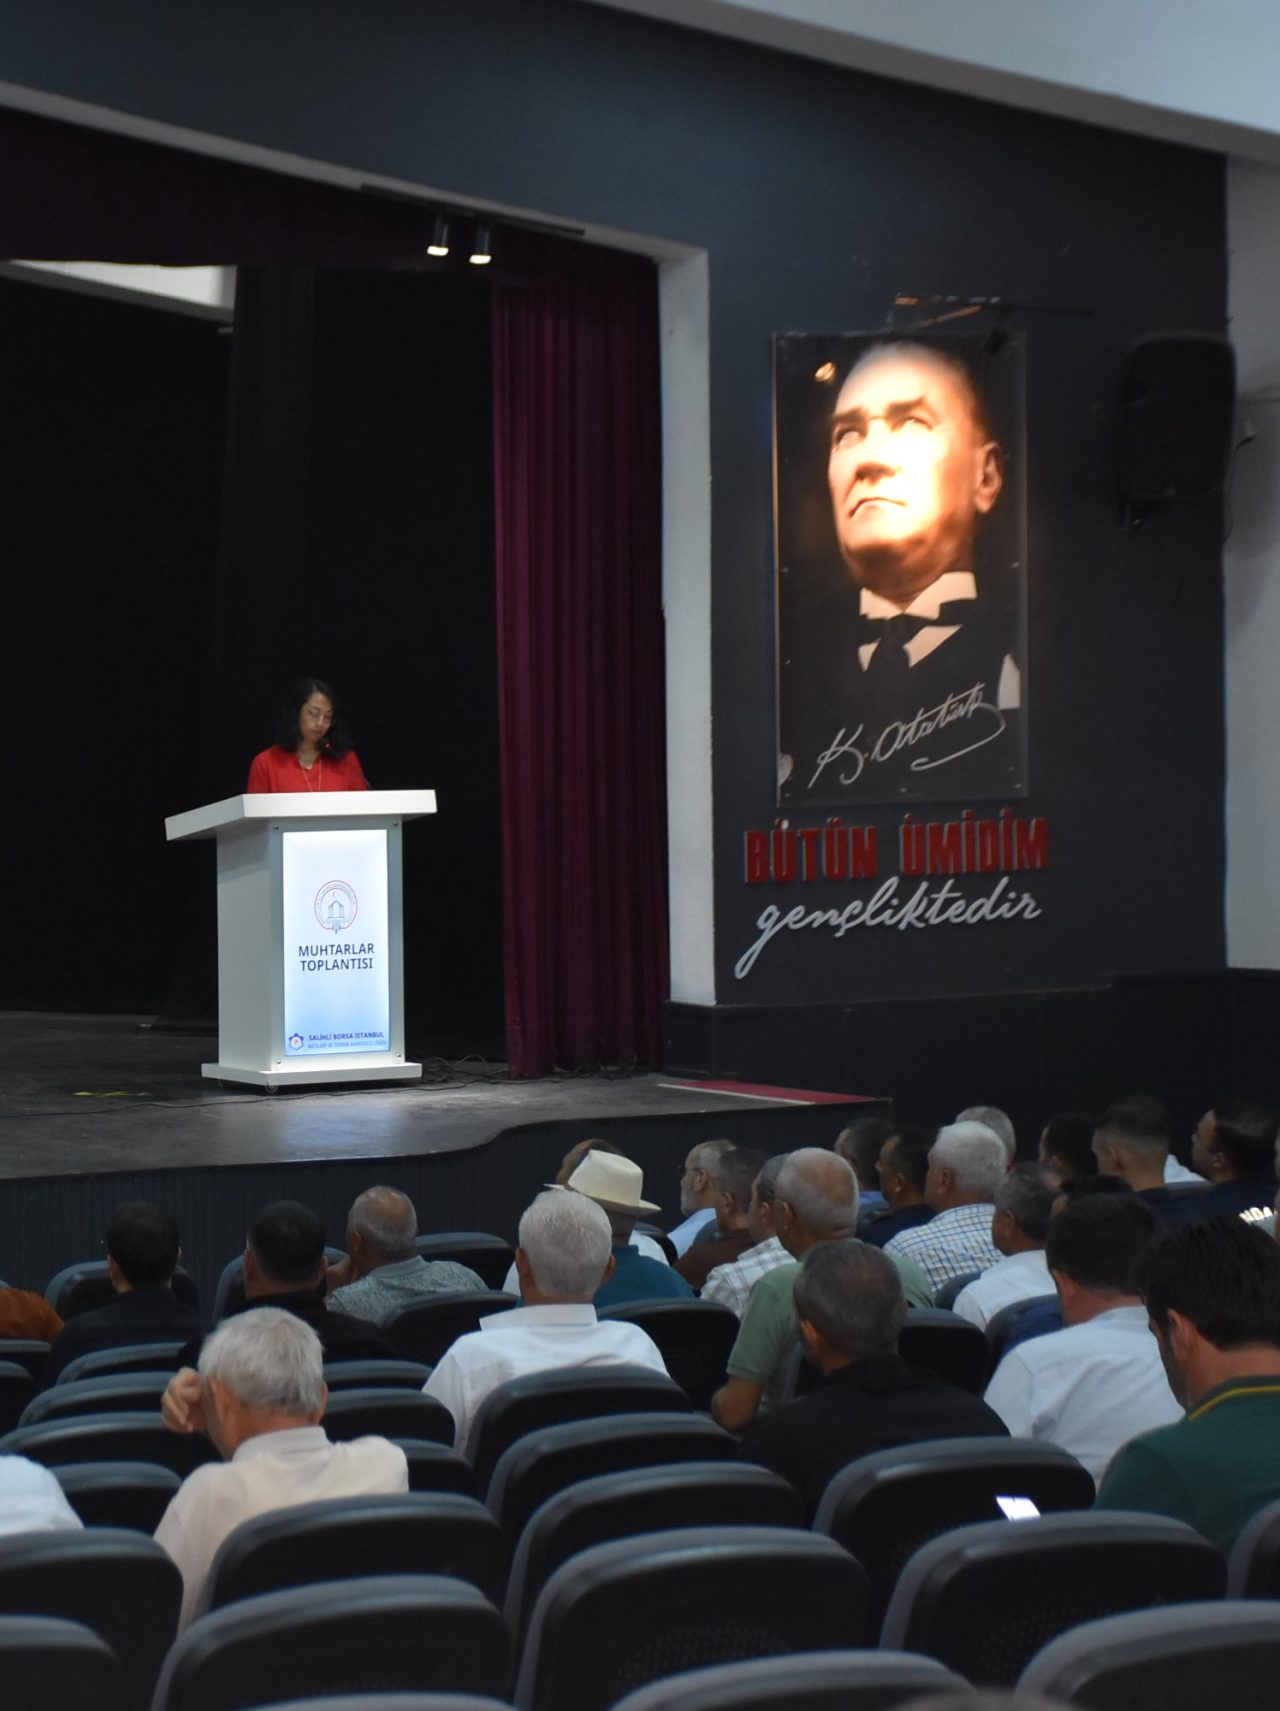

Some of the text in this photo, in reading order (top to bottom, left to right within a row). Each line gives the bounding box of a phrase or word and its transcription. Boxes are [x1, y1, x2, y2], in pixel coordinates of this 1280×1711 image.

[744, 817, 878, 885] BÜTÜN
[734, 876, 1043, 979] gençliktedir
[298, 942, 375, 957] MUHTARLAR
[299, 957, 373, 972] TOPLANTISI
